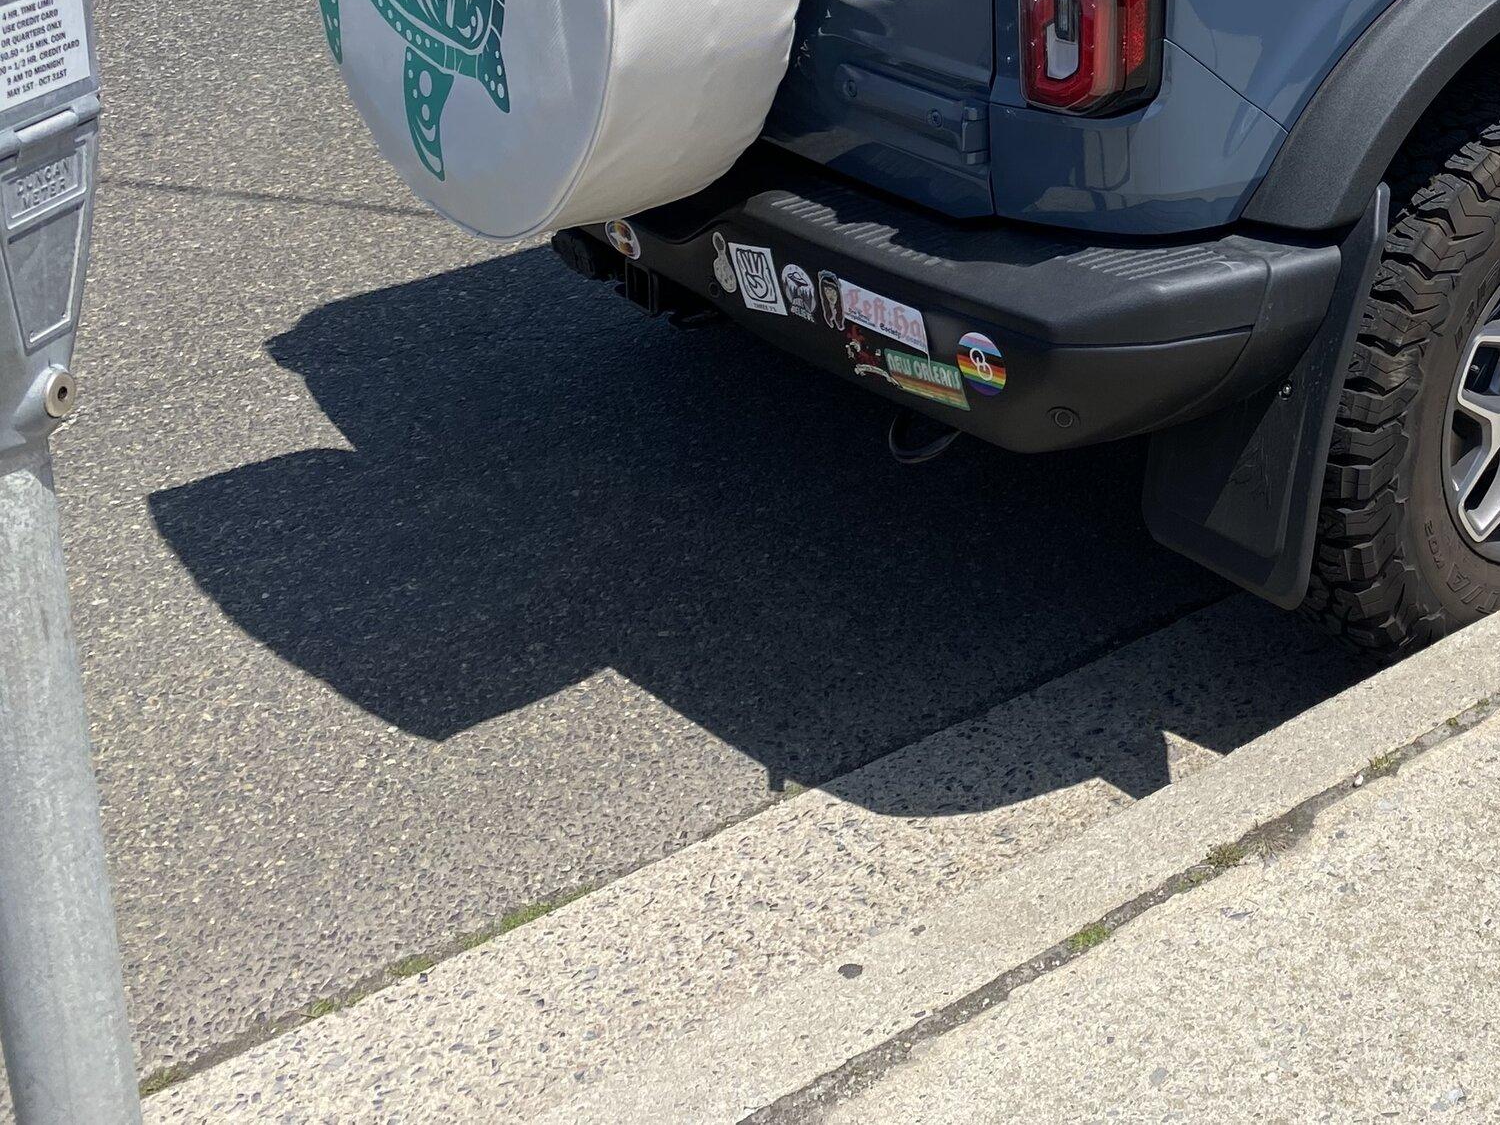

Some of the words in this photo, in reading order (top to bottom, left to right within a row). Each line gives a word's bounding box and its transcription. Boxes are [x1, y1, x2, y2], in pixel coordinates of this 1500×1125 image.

[2, 24, 16, 35] USE
[16, 15, 40, 29] CREDIT
[40, 9, 59, 21] CARD
[20, 3, 37, 14] TIME
[1, 38, 11, 48] OR
[11, 25, 46, 45] QUARTERS
[46, 20, 62, 32] ONLY
[26, 43, 35, 53] 15
[50, 32, 67, 44] COIN
[39, 46, 62, 60] CREDIT
[62, 39, 80, 51] CARD
[7, 86, 21, 99] MAY
[22, 81, 34, 93] 1ST
[38, 76, 51, 87] OCT
[52, 68, 68, 81] 31ST
[13, 72, 24, 83] AM
[25, 69, 33, 79] TO
[34, 57, 65, 75] MIDNIGHT
[16, 156, 71, 196] DUNCAN
[22, 176, 66, 209] METER
[887, 353, 912, 376] NEW
[914, 360, 961, 391] ORLEANS
